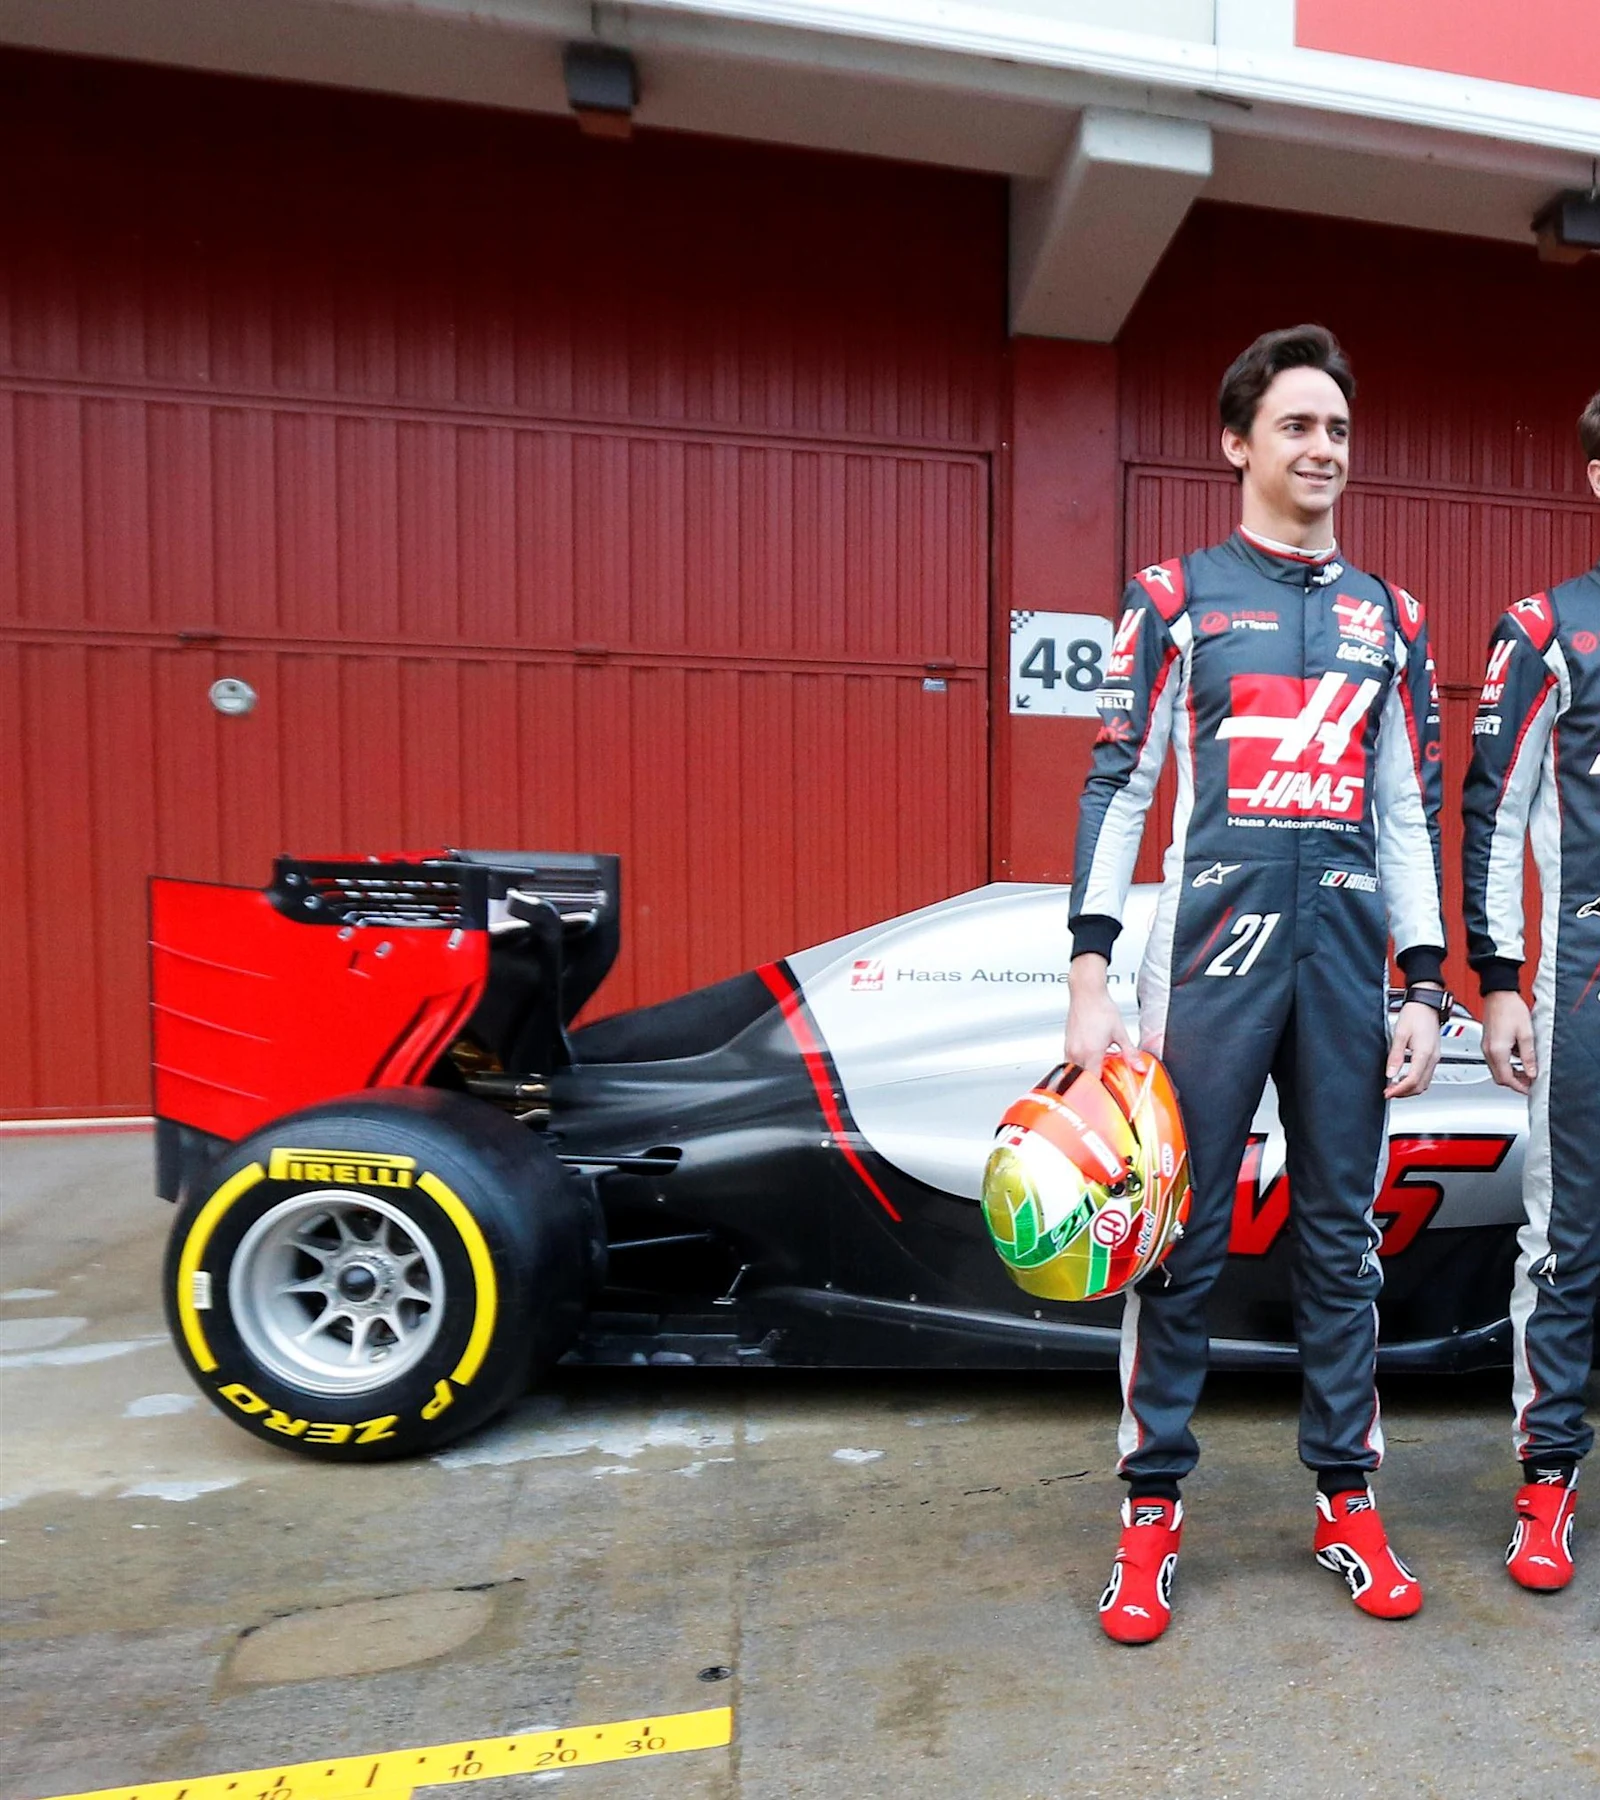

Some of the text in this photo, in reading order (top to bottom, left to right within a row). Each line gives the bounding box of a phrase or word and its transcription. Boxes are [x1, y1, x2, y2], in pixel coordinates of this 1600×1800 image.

[1019, 637, 1104, 692] 48
[1228, 770, 1365, 812] HAAS
[1227, 817, 1266, 827] Haas
[1204, 912, 1281, 977] 21
[896, 968, 962, 982] Haas
[268, 1147, 417, 1188] PIRELLI
[218, 1378, 454, 1444] P ZERO
[534, 1748, 578, 1767] 20
[623, 1736, 666, 1754] 30
[447, 1761, 483, 1778] 10
